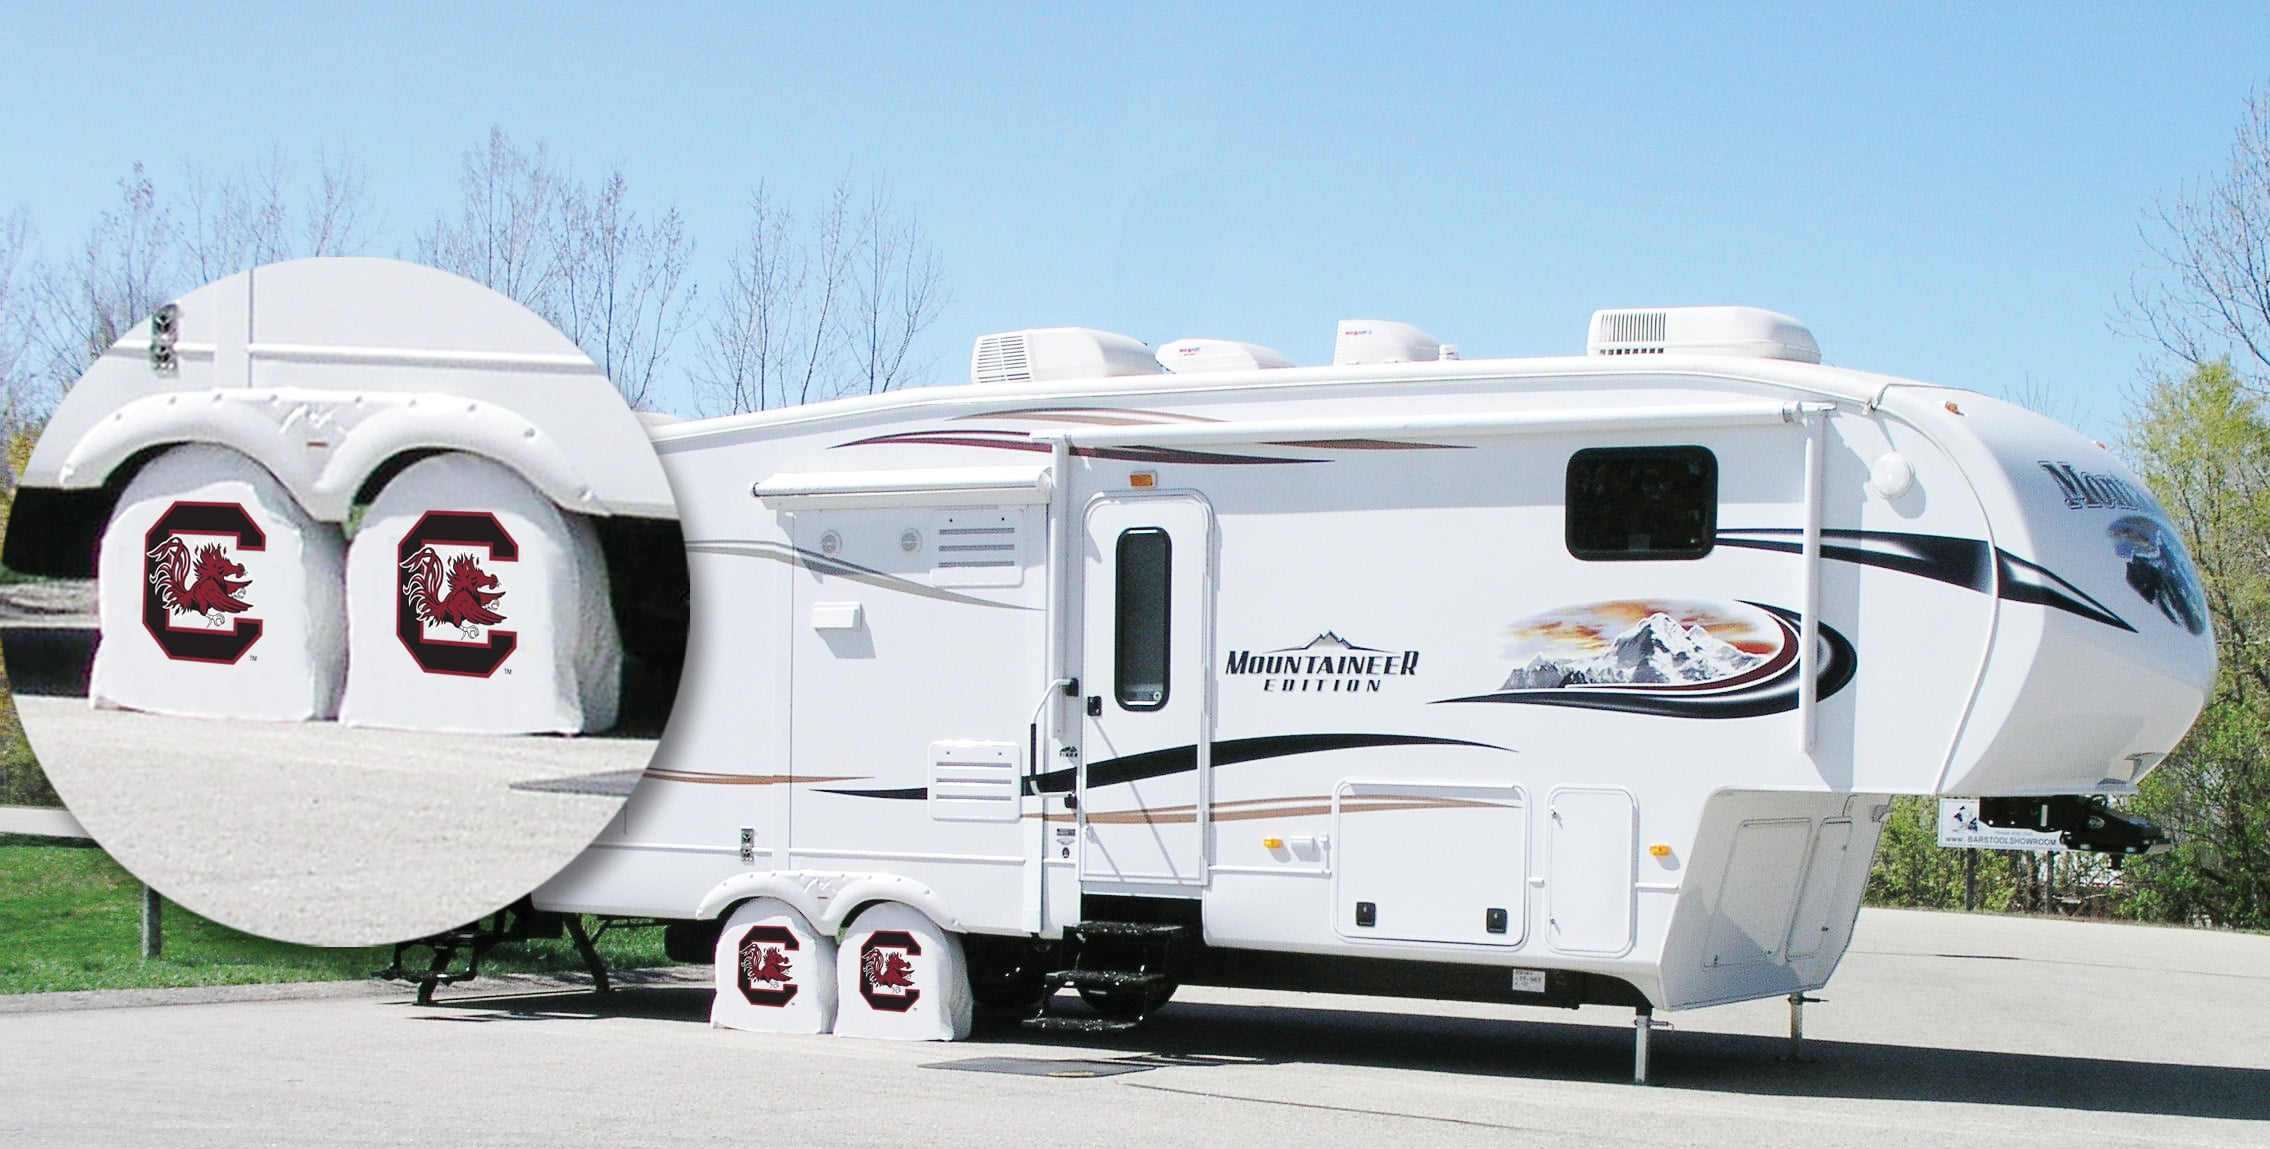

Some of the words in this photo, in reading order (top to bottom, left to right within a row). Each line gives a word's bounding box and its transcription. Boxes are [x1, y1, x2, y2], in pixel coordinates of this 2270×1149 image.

[142, 501, 266, 665] C
[396, 510, 519, 678] C
[1226, 650, 1419, 676] MOUNTAINEER
[1264, 678, 1381, 692] EDITION
[737, 925, 799, 1007] C
[859, 930, 921, 1013] C
